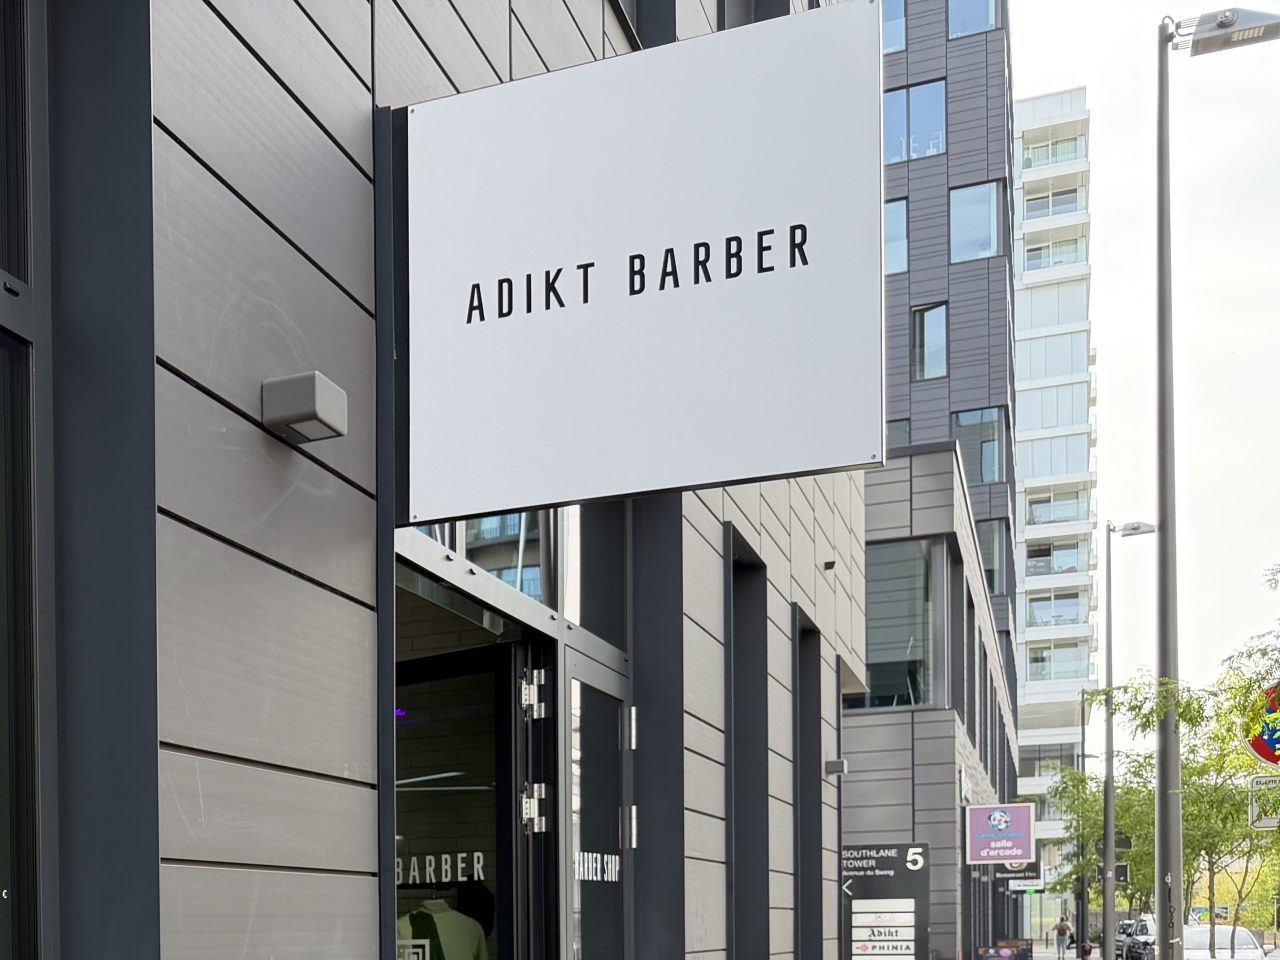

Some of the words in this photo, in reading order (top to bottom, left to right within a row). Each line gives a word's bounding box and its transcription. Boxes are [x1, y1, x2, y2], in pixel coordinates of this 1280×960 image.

[465, 261, 596, 325] ADIKT
[628, 223, 810, 297] BARBER
[990, 840, 1013, 848] salle
[841, 848, 898, 859] SOUTHLANE
[980, 848, 1023, 857] d'arcade
[841, 859, 876, 868] TOWER
[905, 847, 925, 871] 5
[395, 851, 486, 886] BARBER
